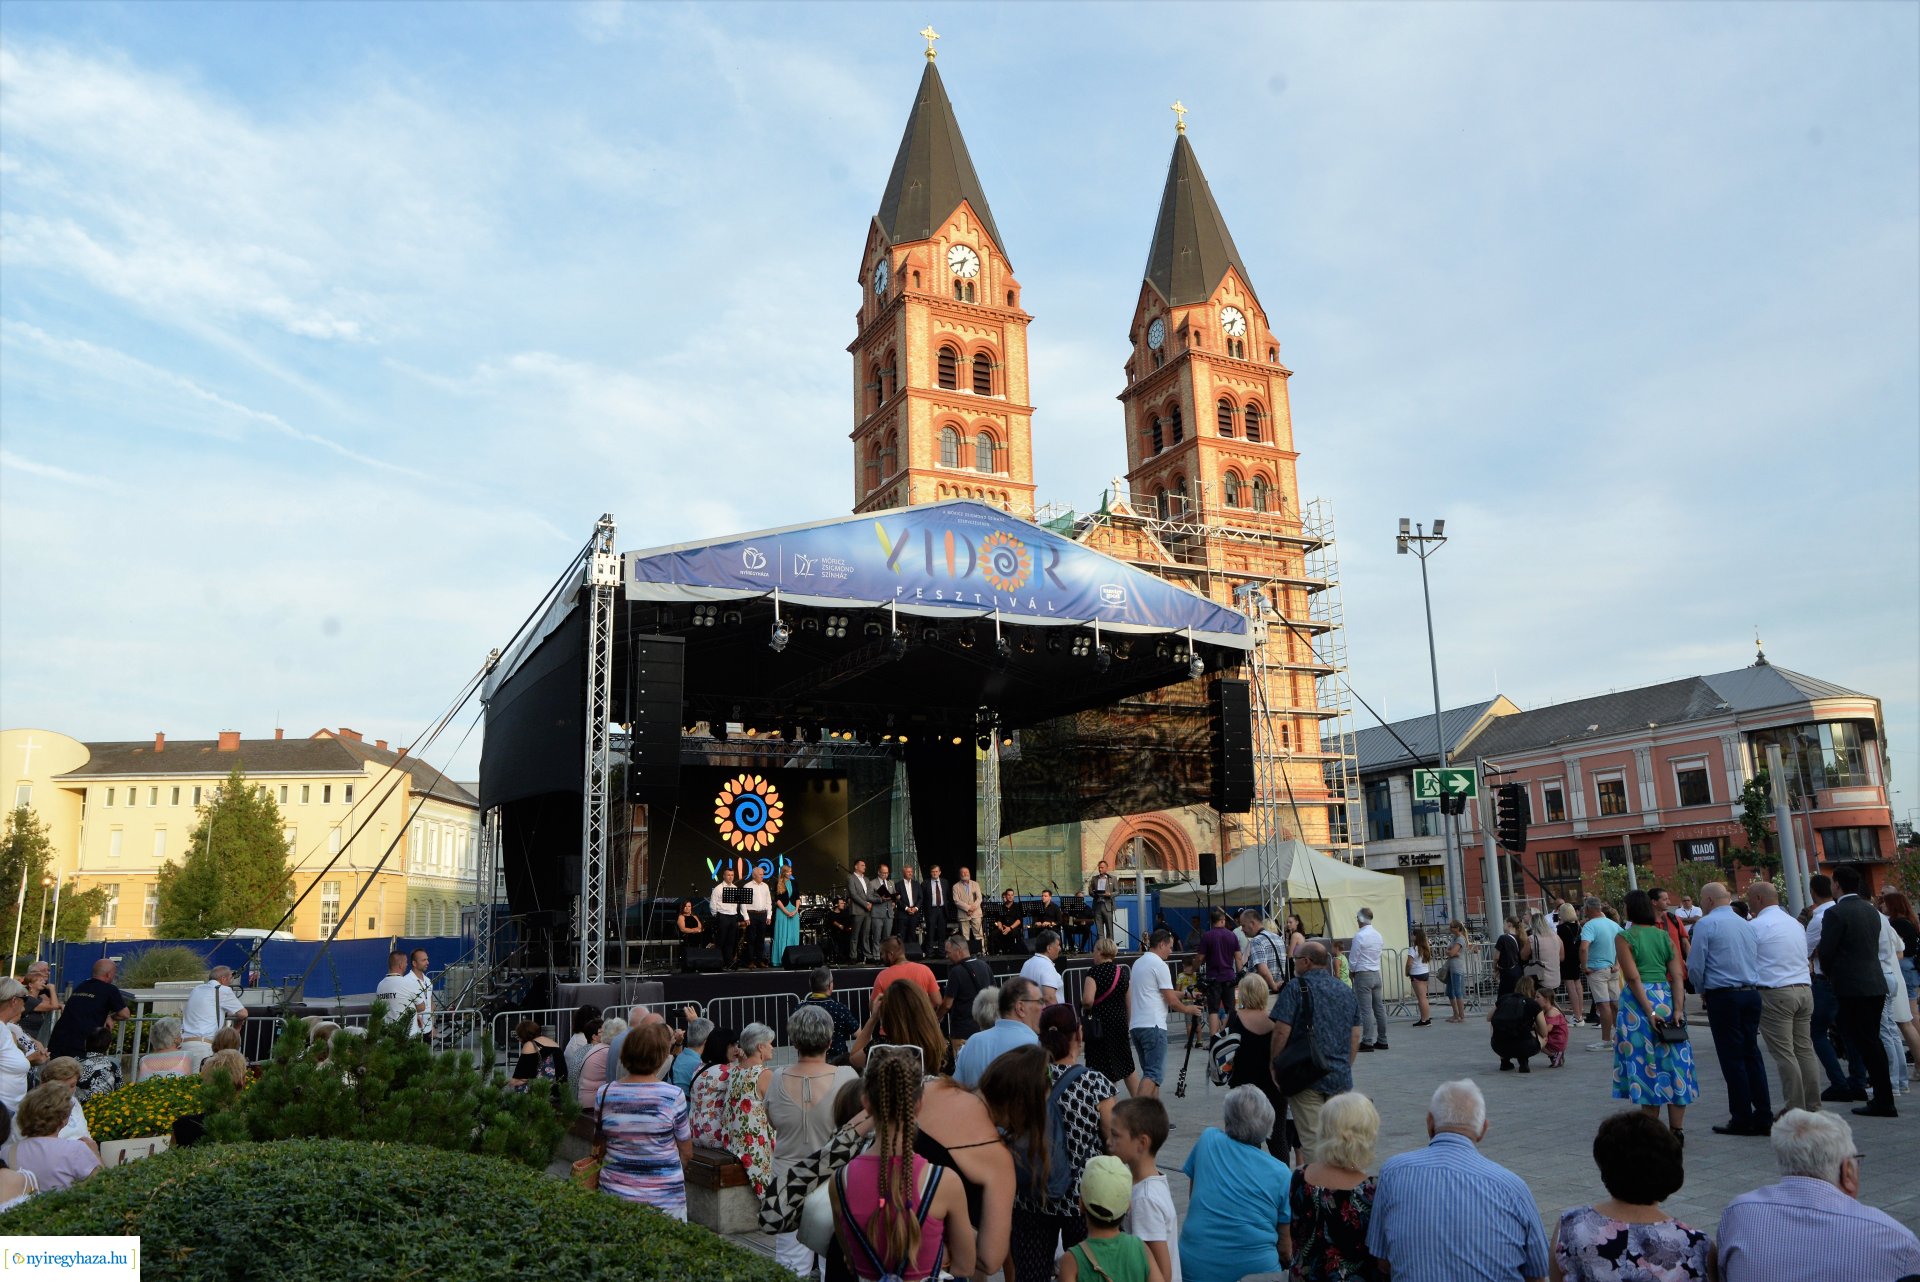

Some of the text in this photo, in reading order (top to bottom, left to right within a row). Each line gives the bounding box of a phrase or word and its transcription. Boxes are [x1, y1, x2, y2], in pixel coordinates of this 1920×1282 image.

[821, 556, 845, 565] MÓRICZ
[874, 521, 1067, 592] VIDOR
[821, 564, 855, 573] ZSIGMOND
[821, 571, 848, 580] SZÍNHÁZ
[896, 586, 1055, 611] FESZTIVÁL
[1691, 841, 1715, 855] KIADÓ
